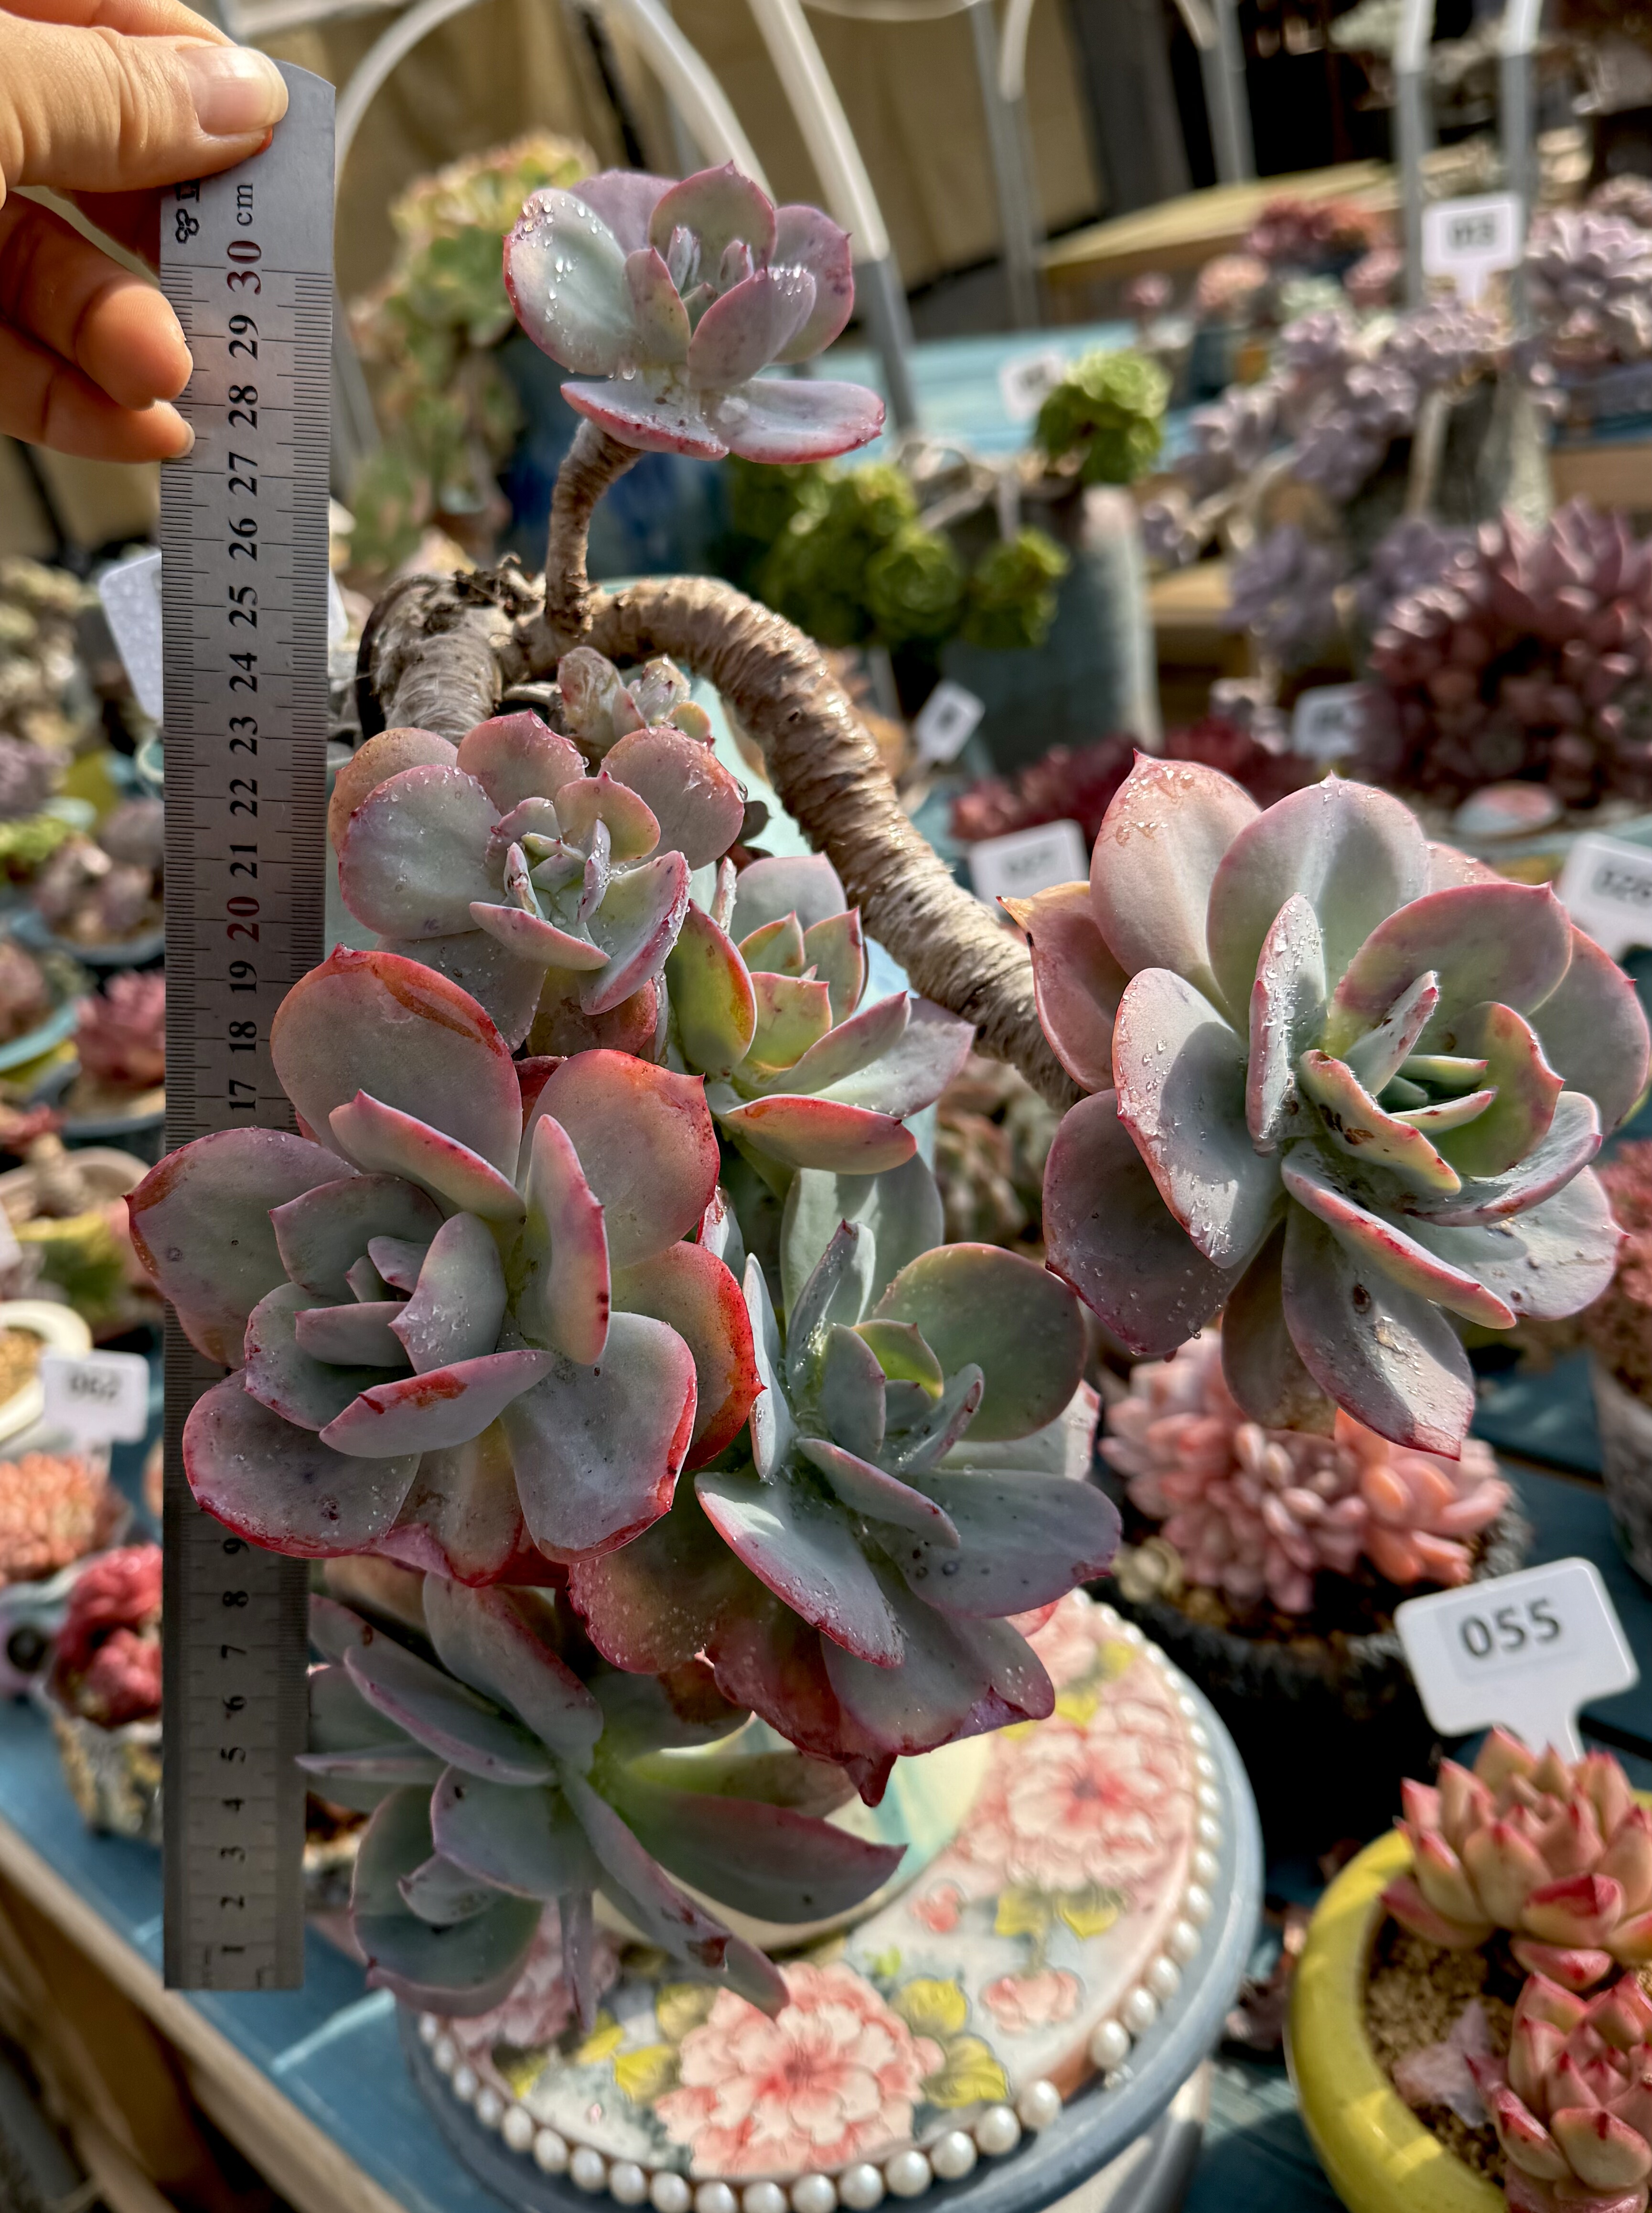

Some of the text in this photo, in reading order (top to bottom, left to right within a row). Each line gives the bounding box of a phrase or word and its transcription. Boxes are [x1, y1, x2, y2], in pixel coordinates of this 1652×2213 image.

[236, 183, 253, 226] cm
[226, 240, 262, 295] 30
[229, 314, 258, 361] 29
[228, 385, 258, 430] 28
[229, 451, 257, 497] 27
[228, 517, 257, 562] 26
[229, 586, 258, 629] 25
[229, 652, 257, 693] 24
[229, 716, 258, 756] 23
[229, 778, 258, 818] 22
[229, 842, 258, 879] 21
[227, 896, 259, 943] 20
[229, 960, 257, 994] 19
[229, 1021, 257, 1054] 18
[229, 1079, 256, 1112] 17
[223, 1537, 249, 1555] 9
[222, 1590, 249, 1608] 8
[1460, 1597, 1561, 1659] 055
[221, 1644, 247, 1659] 7
[223, 1695, 247, 1711] 6
[220, 1747, 247, 1763] 5
[221, 1798, 245, 1814] 4
[220, 1846, 246, 1862] 3
[220, 1895, 245, 1909] 2
